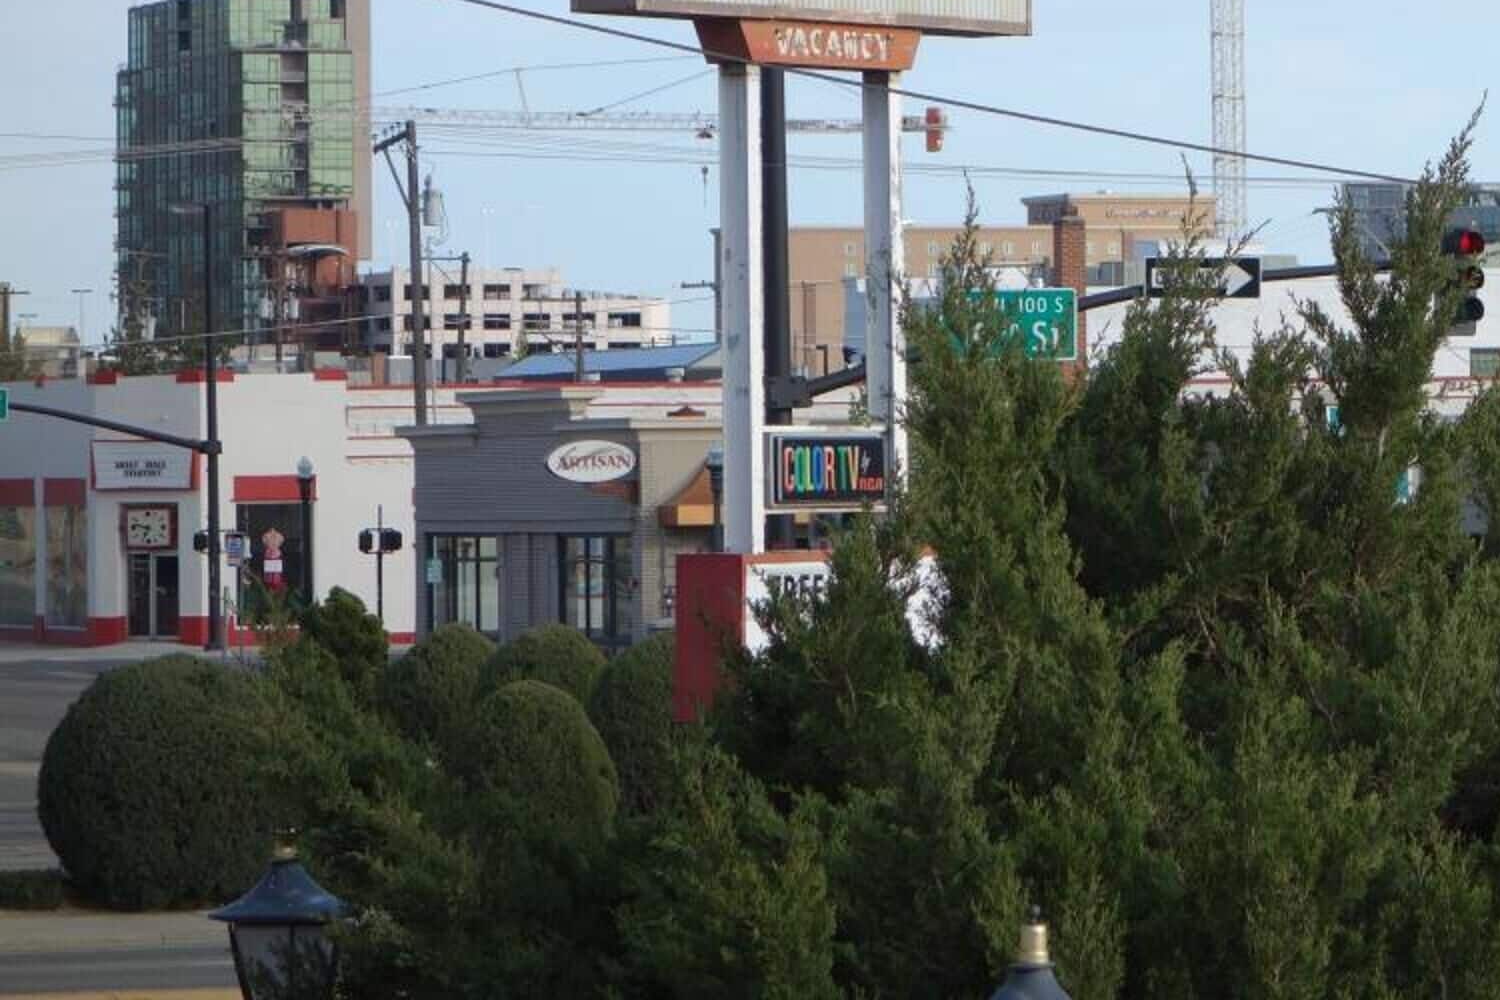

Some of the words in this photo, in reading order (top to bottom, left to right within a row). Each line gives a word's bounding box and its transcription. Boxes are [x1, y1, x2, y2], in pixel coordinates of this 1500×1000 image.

[774, 27, 894, 62] VACANCY
[1018, 296, 1047, 313] 100
[1054, 296, 1064, 313] S
[556, 454, 634, 473] ARTISAN
[783, 445, 836, 492] COLOR
[836, 445, 859, 491] TV
